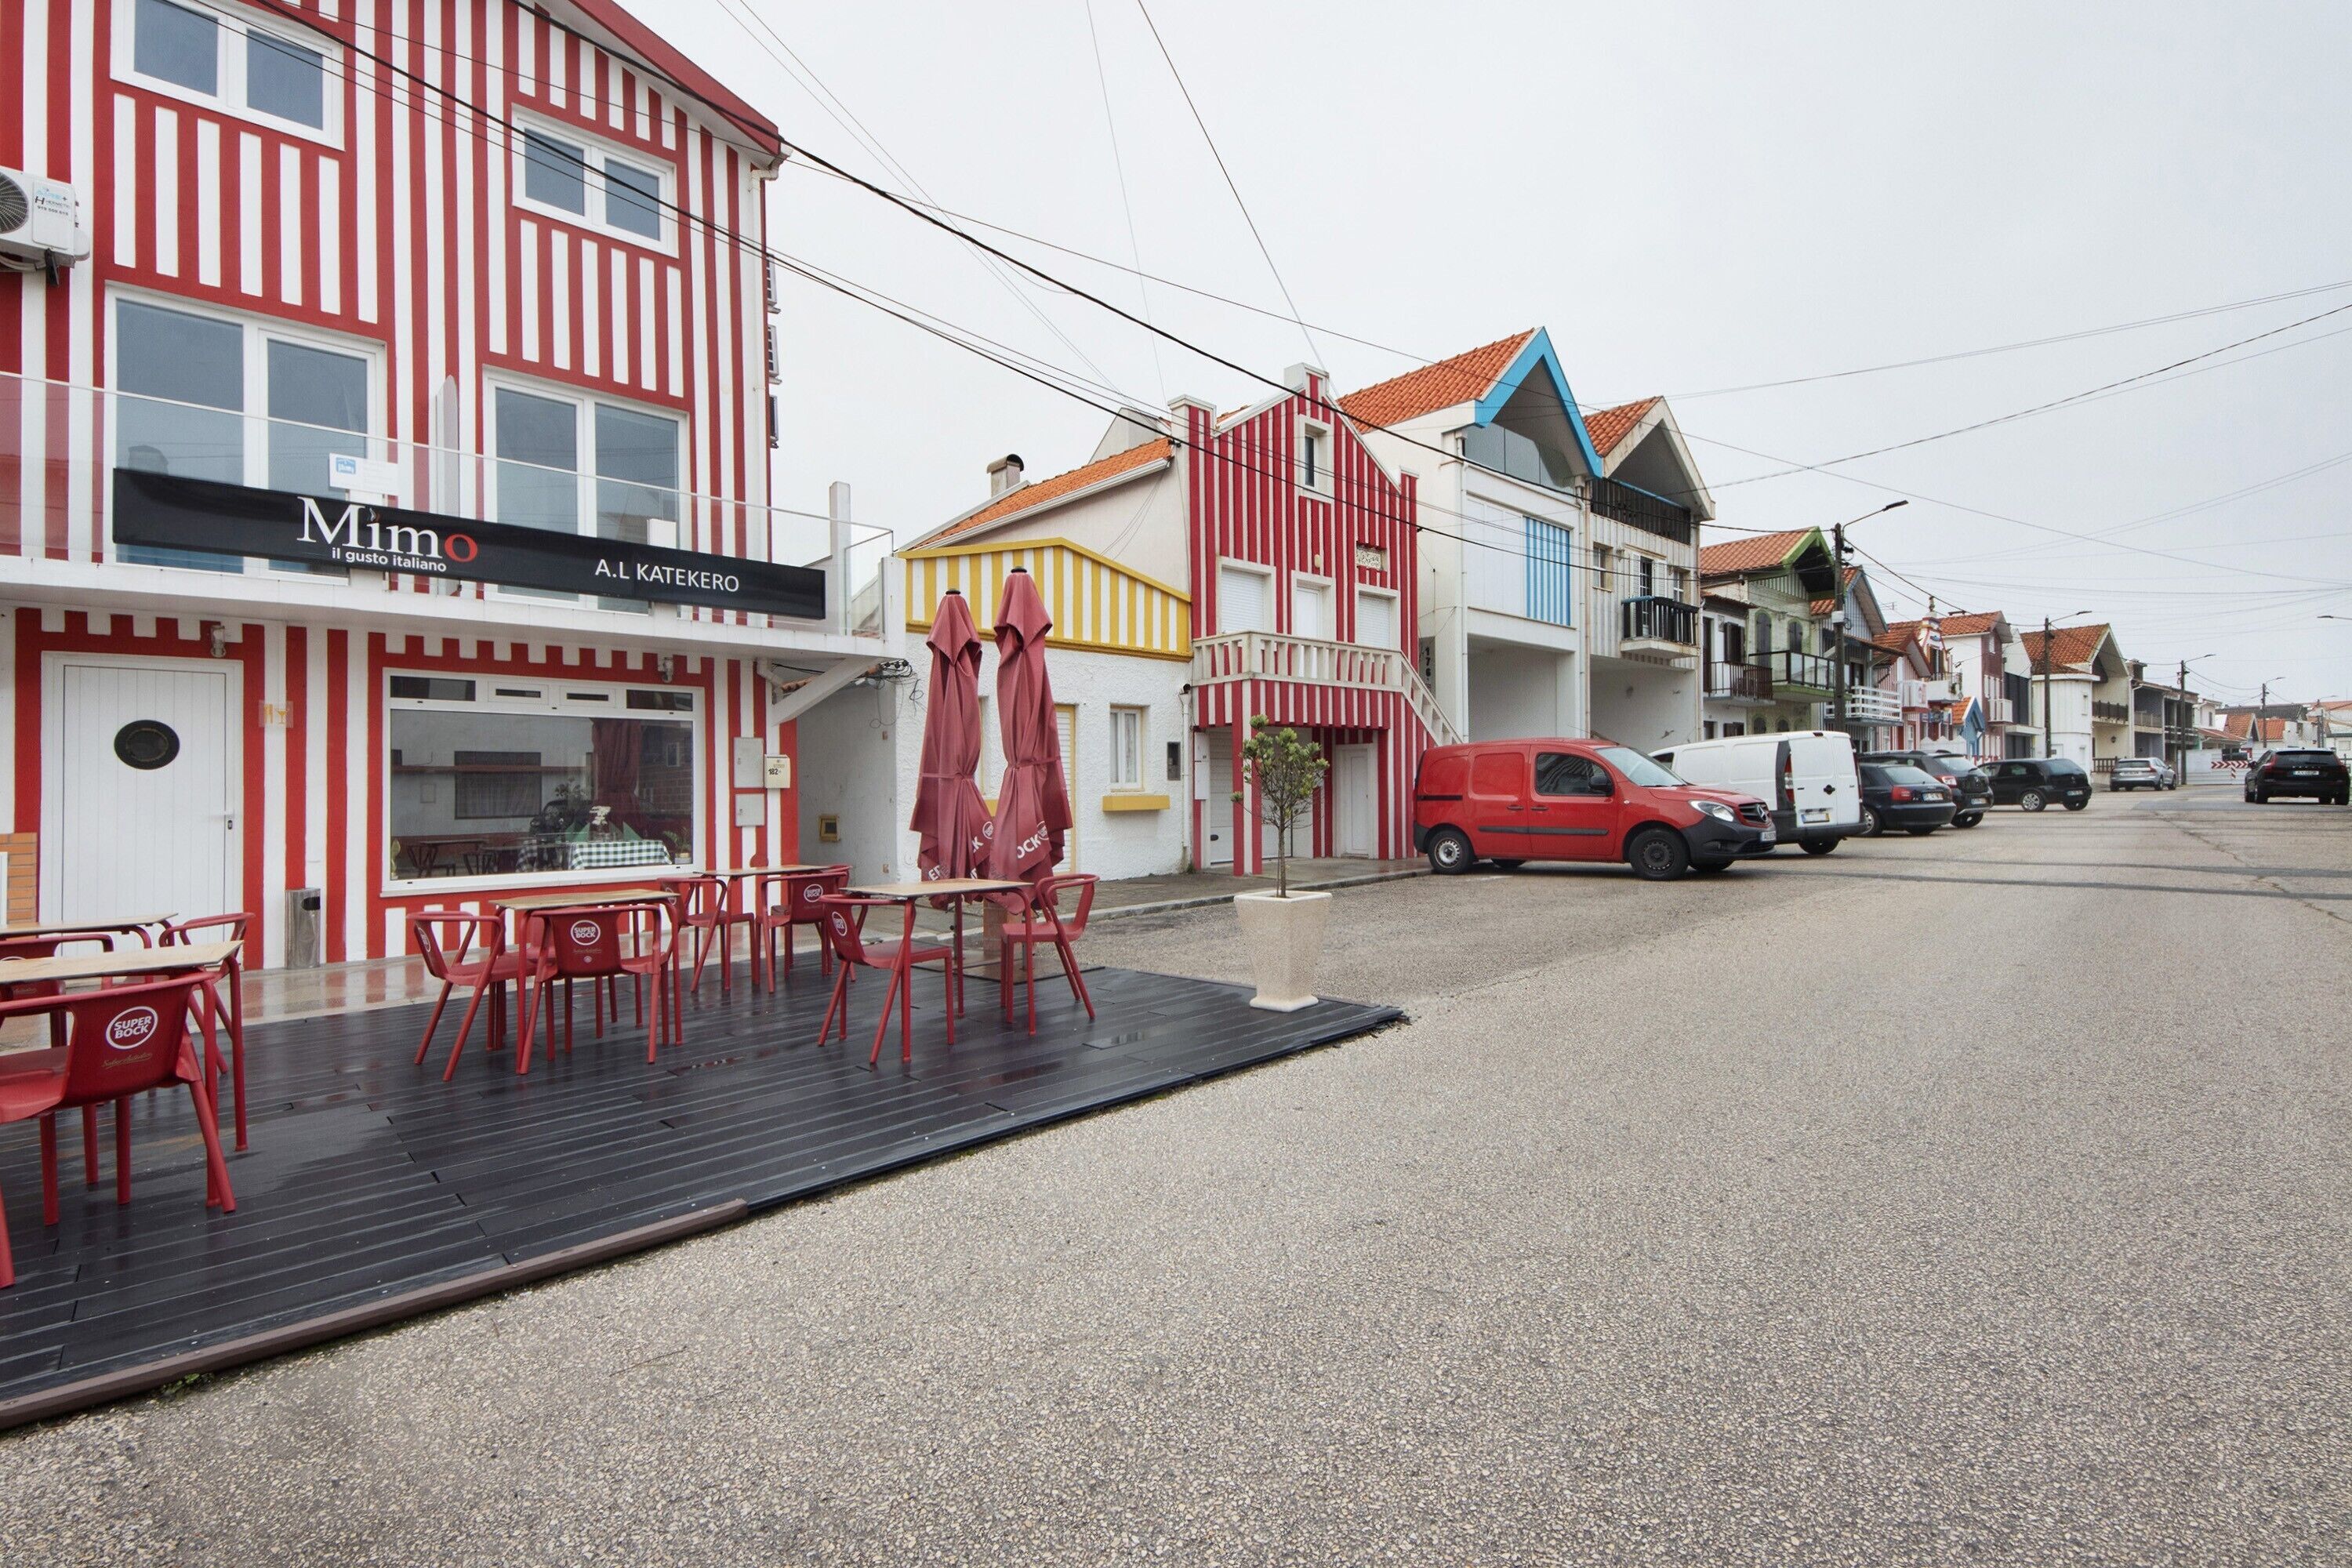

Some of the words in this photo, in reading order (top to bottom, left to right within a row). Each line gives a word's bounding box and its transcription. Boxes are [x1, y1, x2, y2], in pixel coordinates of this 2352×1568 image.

[296, 495, 478, 563] Mimo
[332, 547, 340, 560] il
[345, 550, 388, 565] gusto
[393, 554, 447, 572] italiano
[594, 558, 630, 580] A.L
[637, 562, 740, 593] KATEKERO
[1017, 833, 1041, 859] OCK
[114, 1015, 152, 1031] SUPER
[114, 1024, 149, 1040] BOCK
